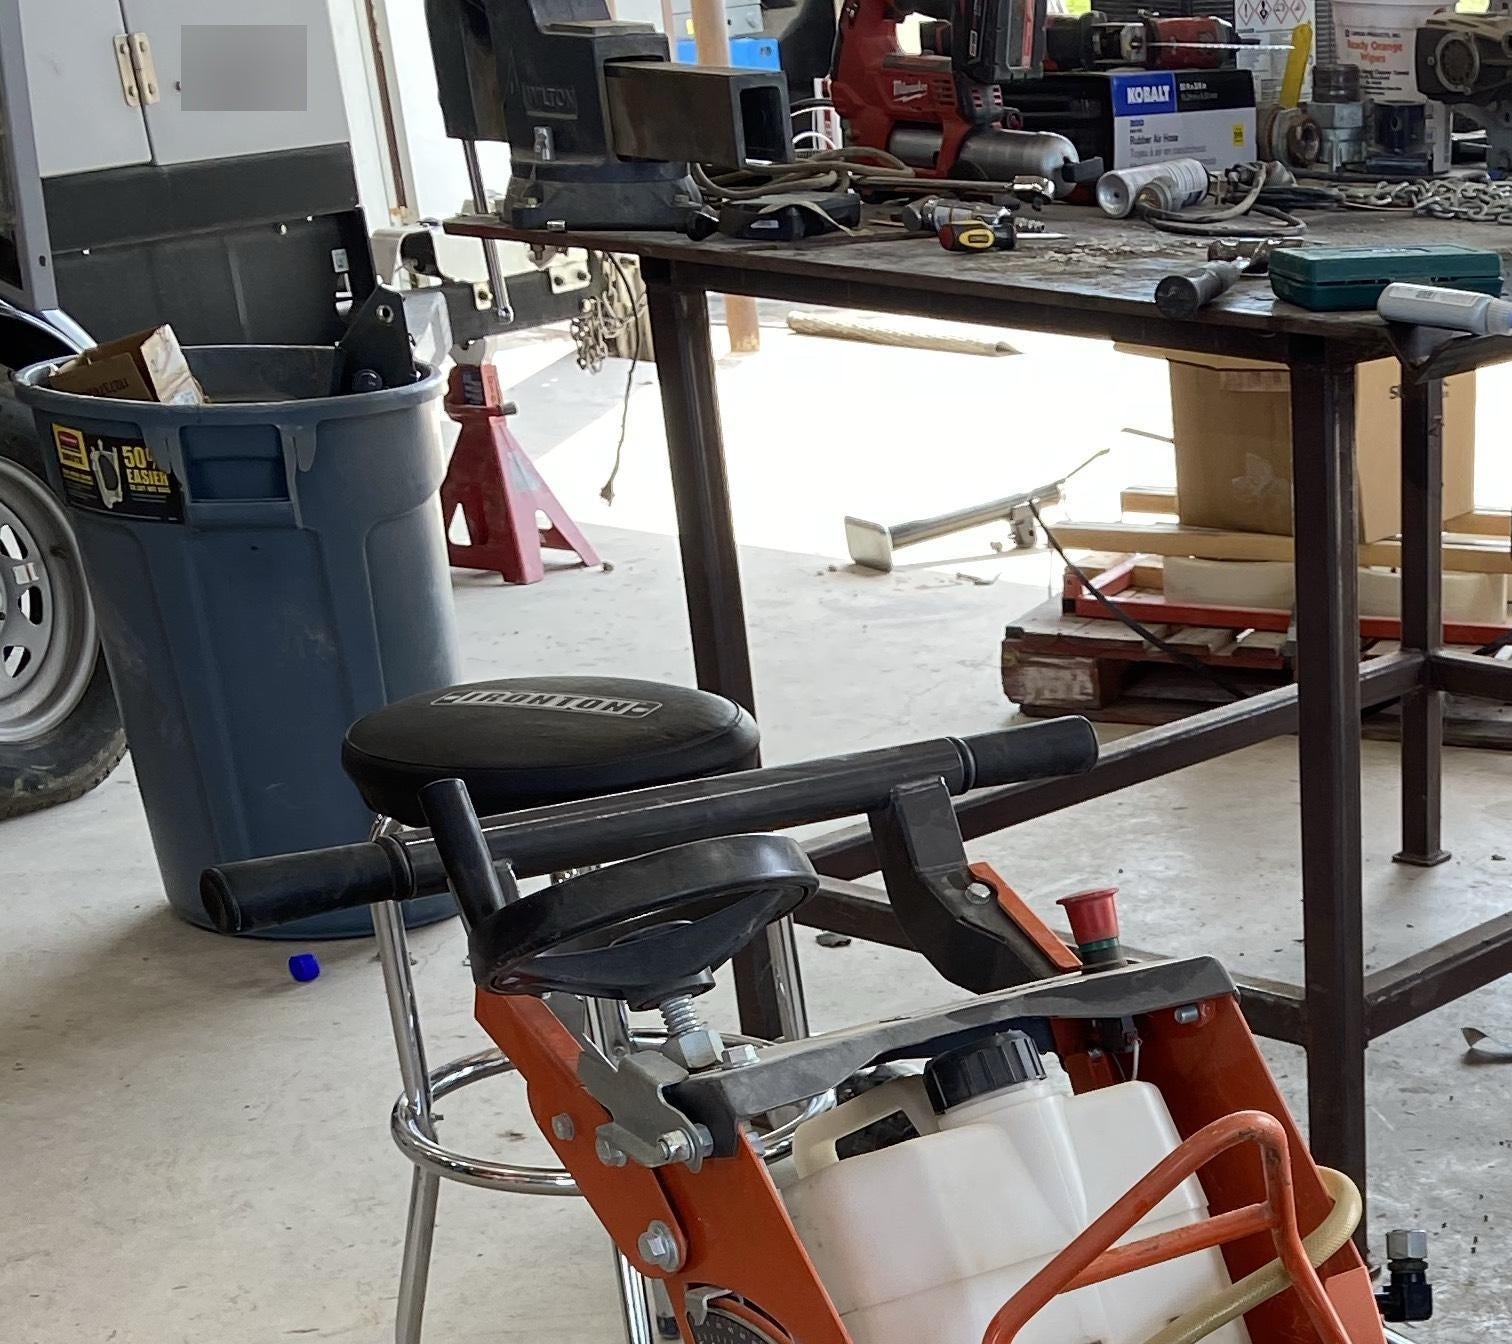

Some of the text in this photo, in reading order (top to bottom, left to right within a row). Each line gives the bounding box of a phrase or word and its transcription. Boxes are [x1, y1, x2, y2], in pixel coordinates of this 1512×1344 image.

[1127, 85, 1170, 104] KOBALT
[126, 469, 169, 485] EASIER
[464, 691, 631, 715] IRONTON
